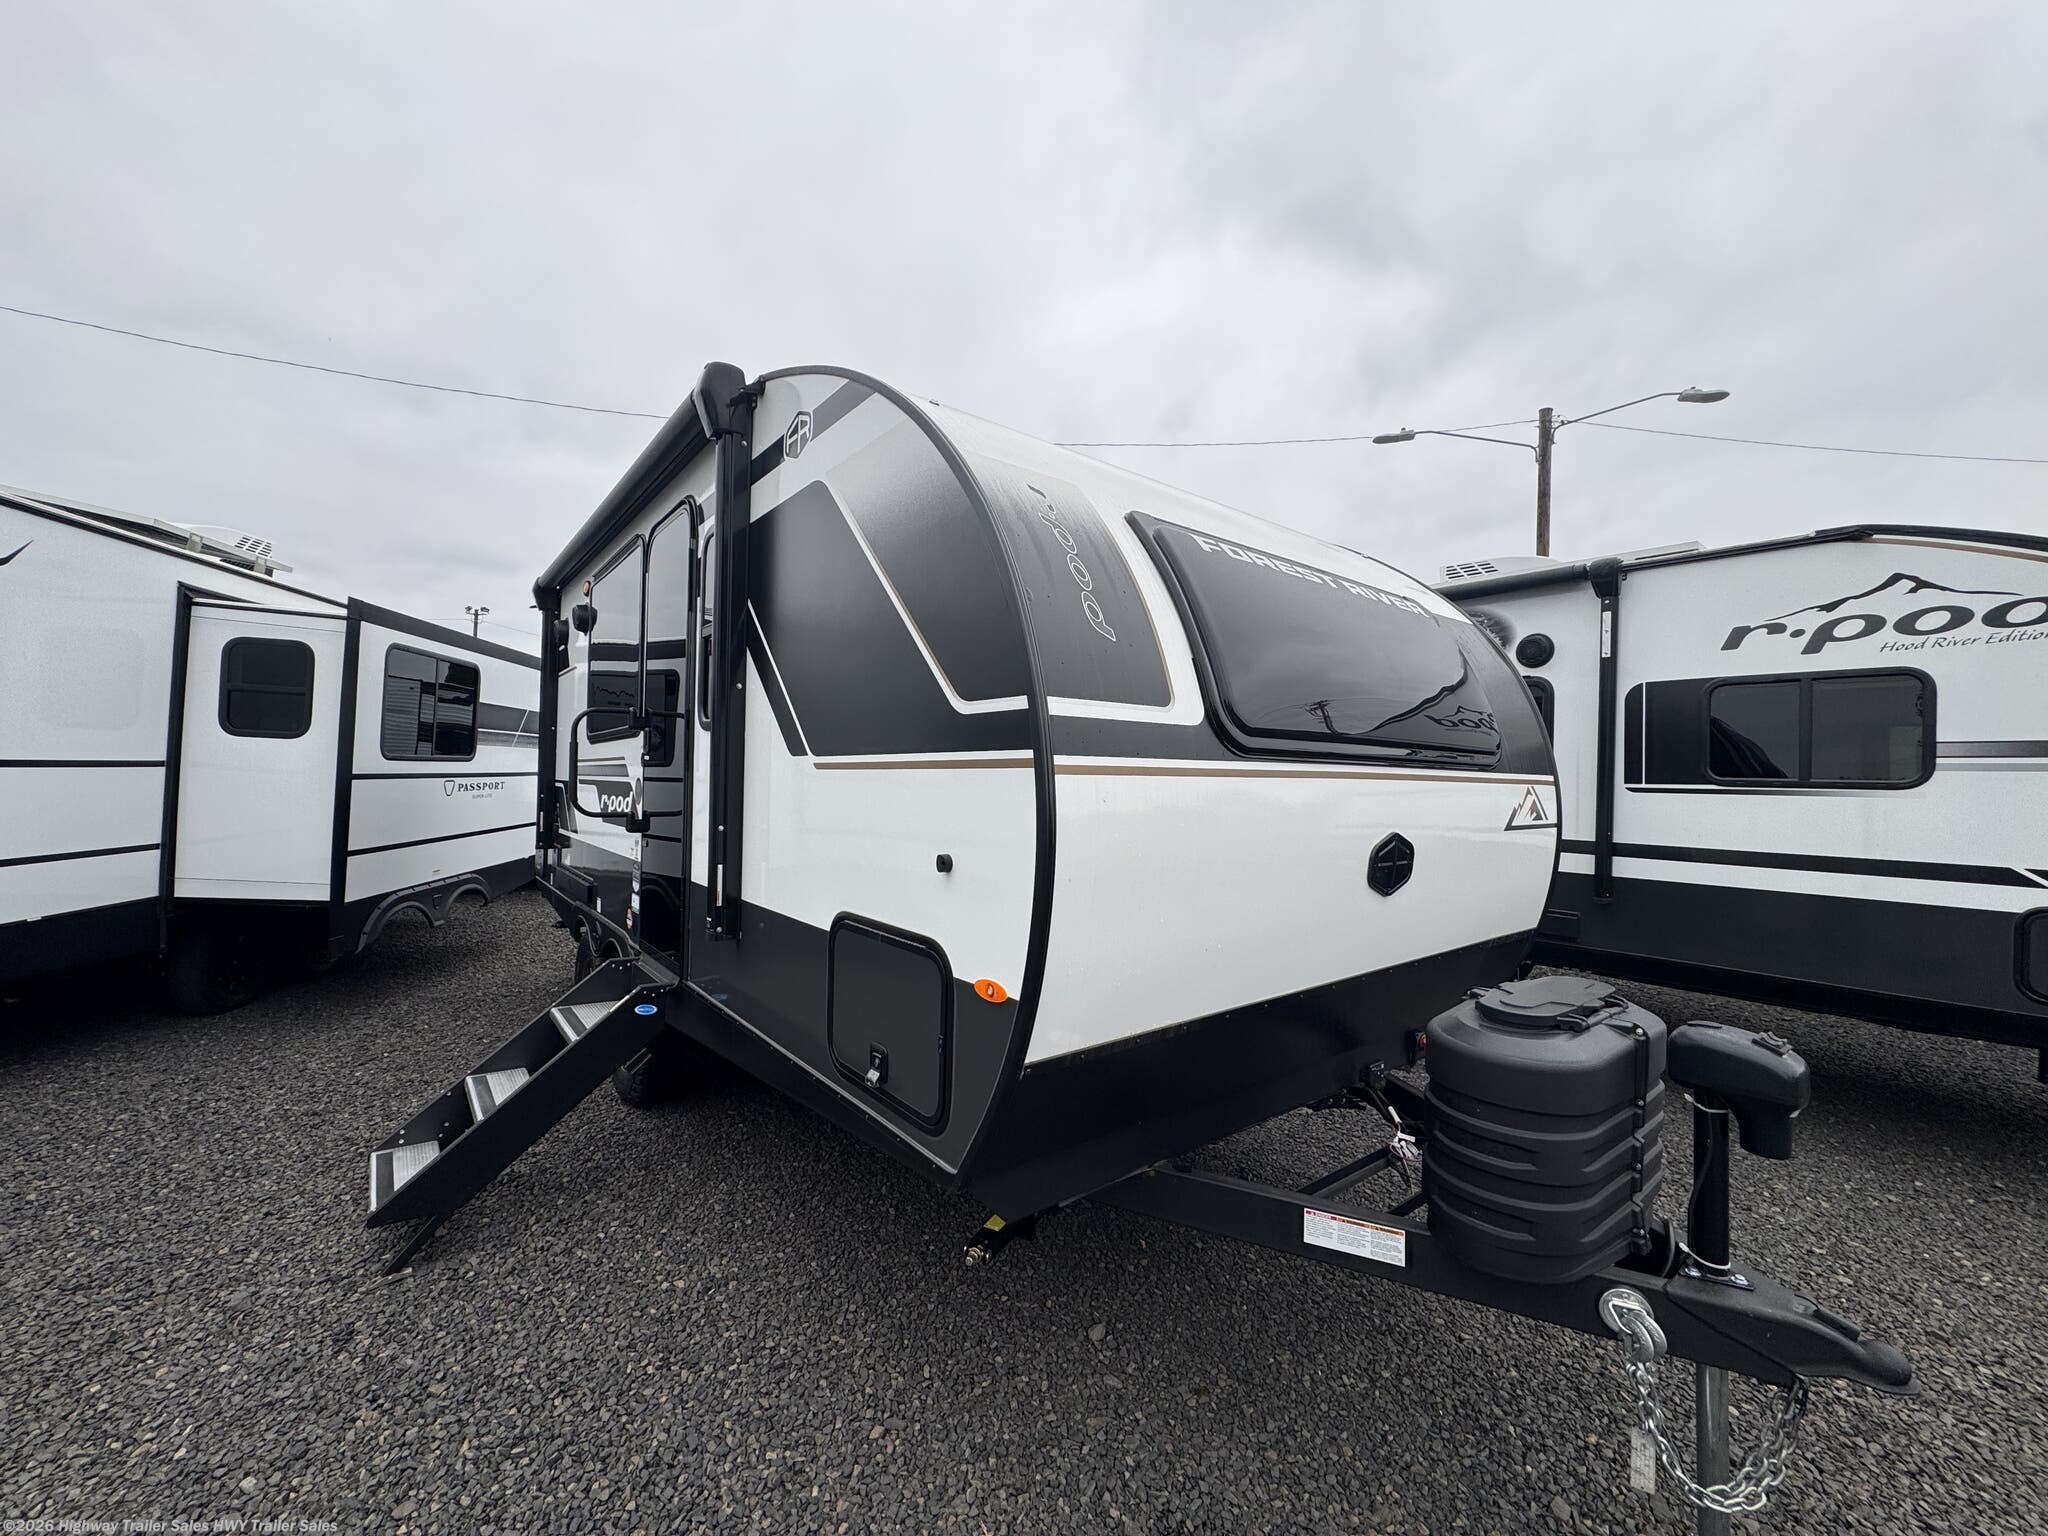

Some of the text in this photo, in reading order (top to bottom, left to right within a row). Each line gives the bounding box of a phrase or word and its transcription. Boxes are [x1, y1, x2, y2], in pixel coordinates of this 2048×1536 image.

[1189, 533, 1430, 618] FOREST RIVER
[1879, 636, 1930, 653] Hood
[1931, 636, 1982, 649] River
[457, 781, 506, 792] PASSPORT
